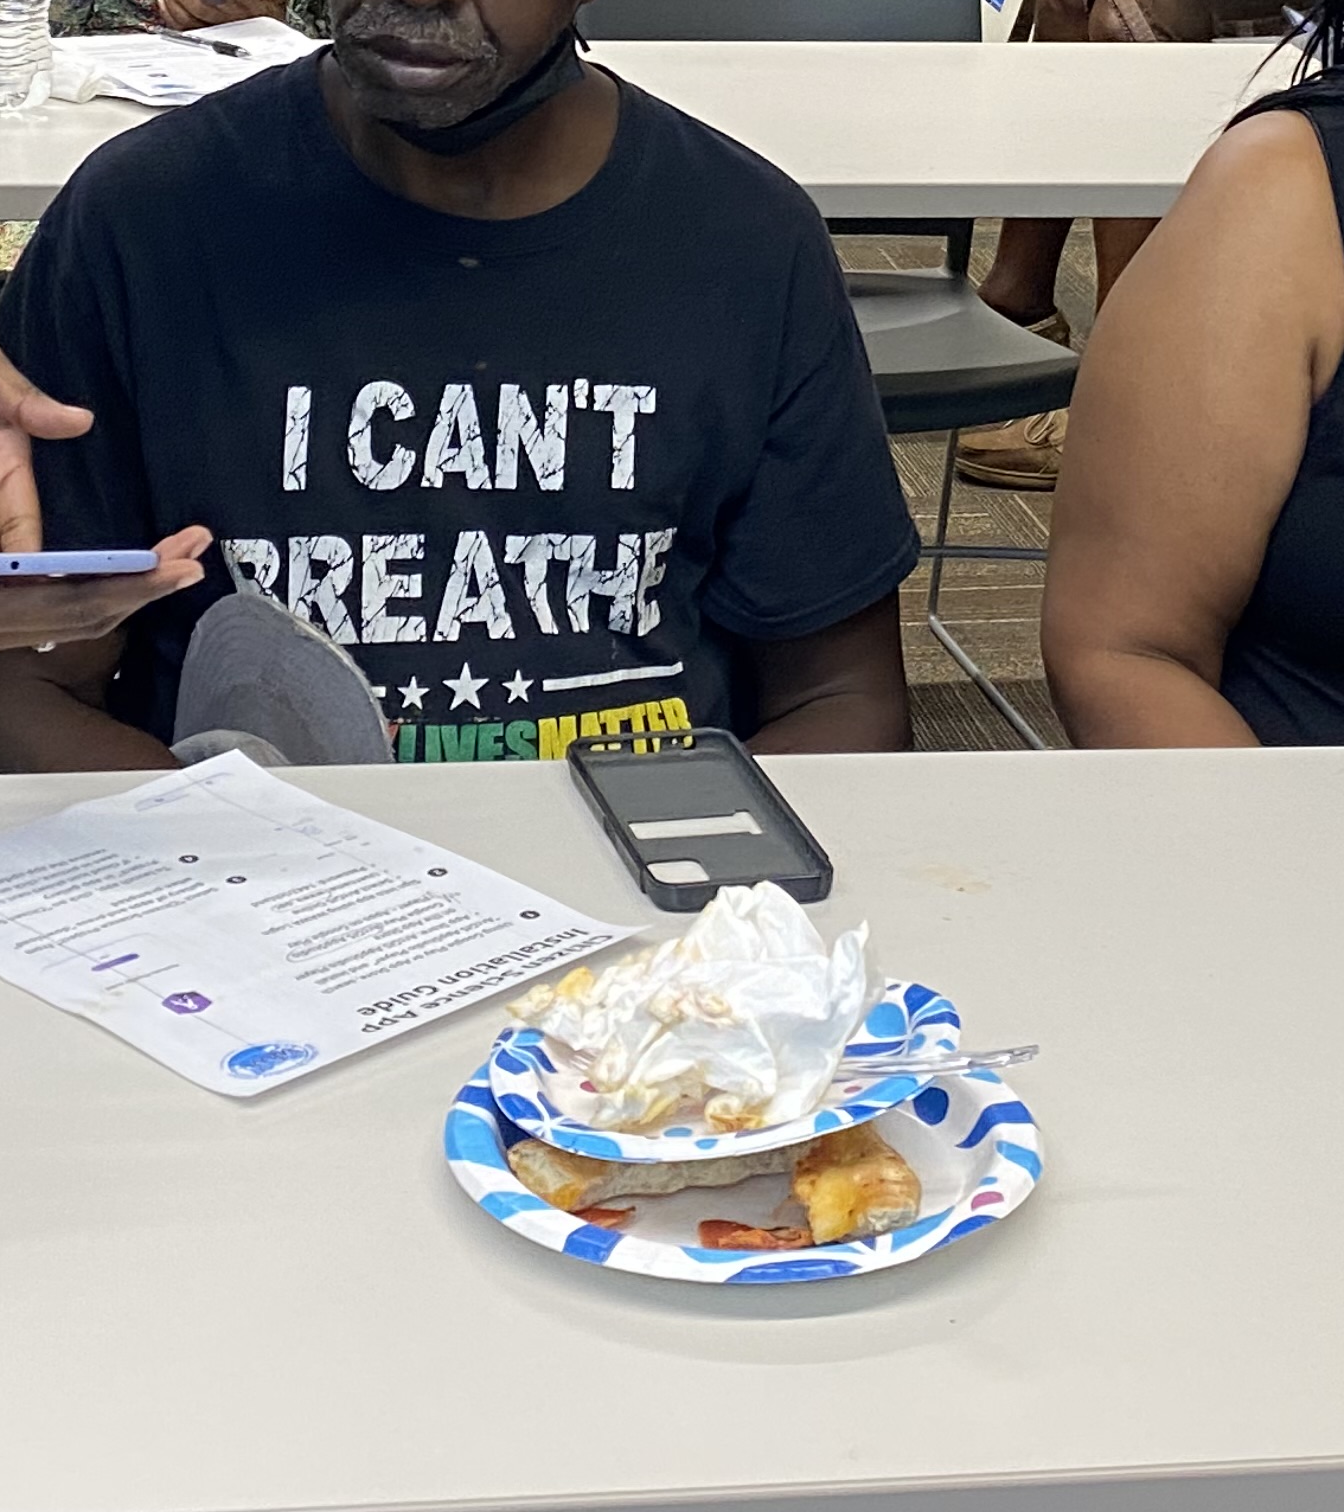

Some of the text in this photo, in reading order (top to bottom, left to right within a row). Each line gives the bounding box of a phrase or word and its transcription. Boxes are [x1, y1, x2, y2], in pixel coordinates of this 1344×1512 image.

[283, 378, 657, 491] I CAN'T
[219, 526, 678, 645] BREATHE
[356, 929, 588, 1016] Installation Guide
[360, 934, 613, 1033] Citizen Science App
